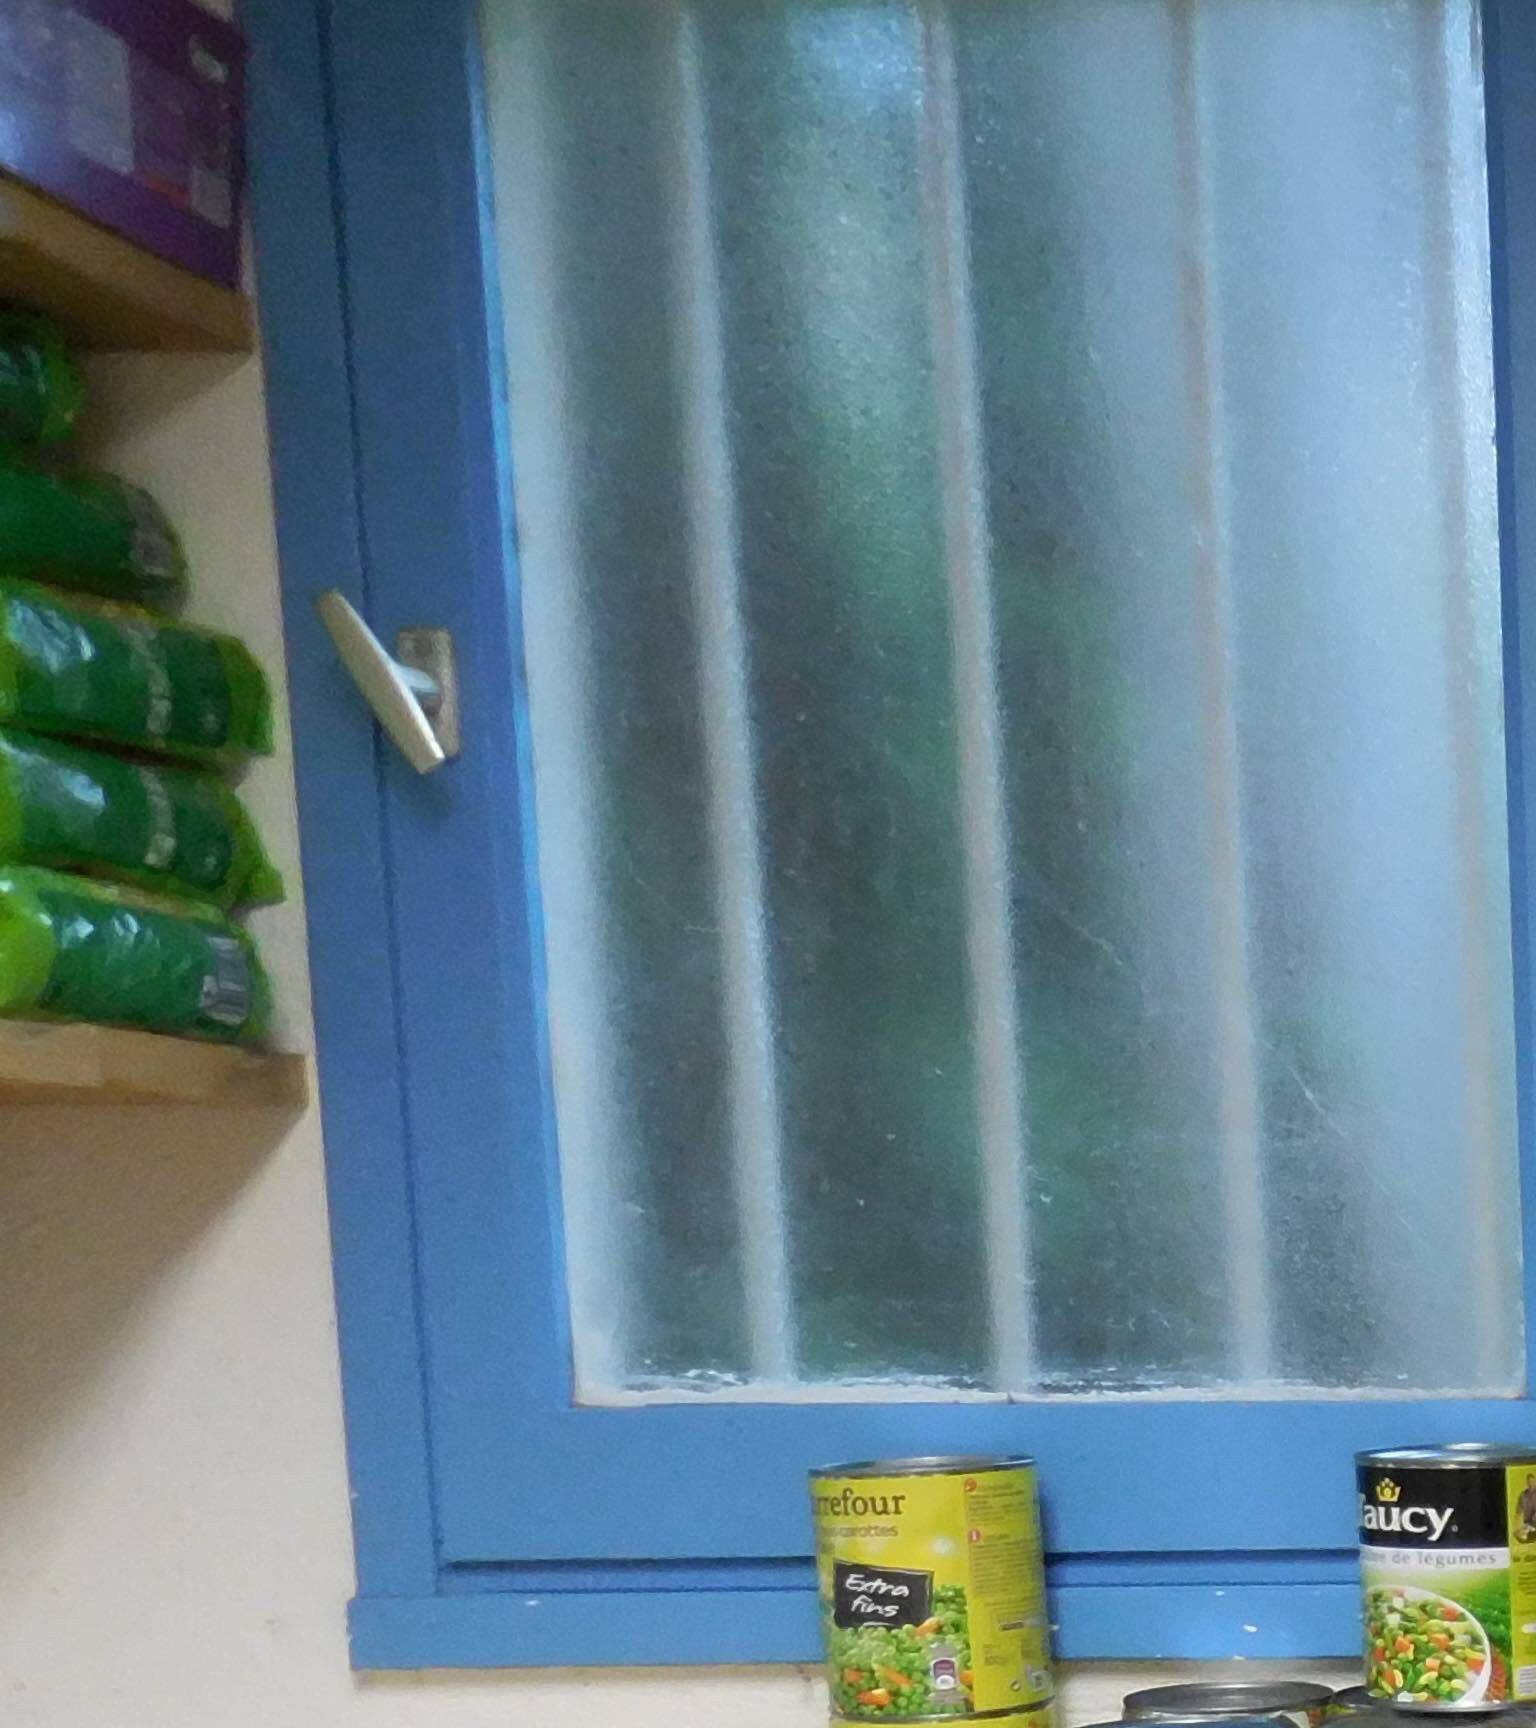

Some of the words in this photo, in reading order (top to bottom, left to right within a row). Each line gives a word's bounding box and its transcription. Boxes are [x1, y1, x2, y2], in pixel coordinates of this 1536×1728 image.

[812, 1488, 906, 1517] rrefour
[1391, 1550, 1411, 1566] de
[1417, 1546, 1498, 1569] légumes
[845, 1574, 910, 1598] Extra
[850, 1598, 899, 1618] fins
